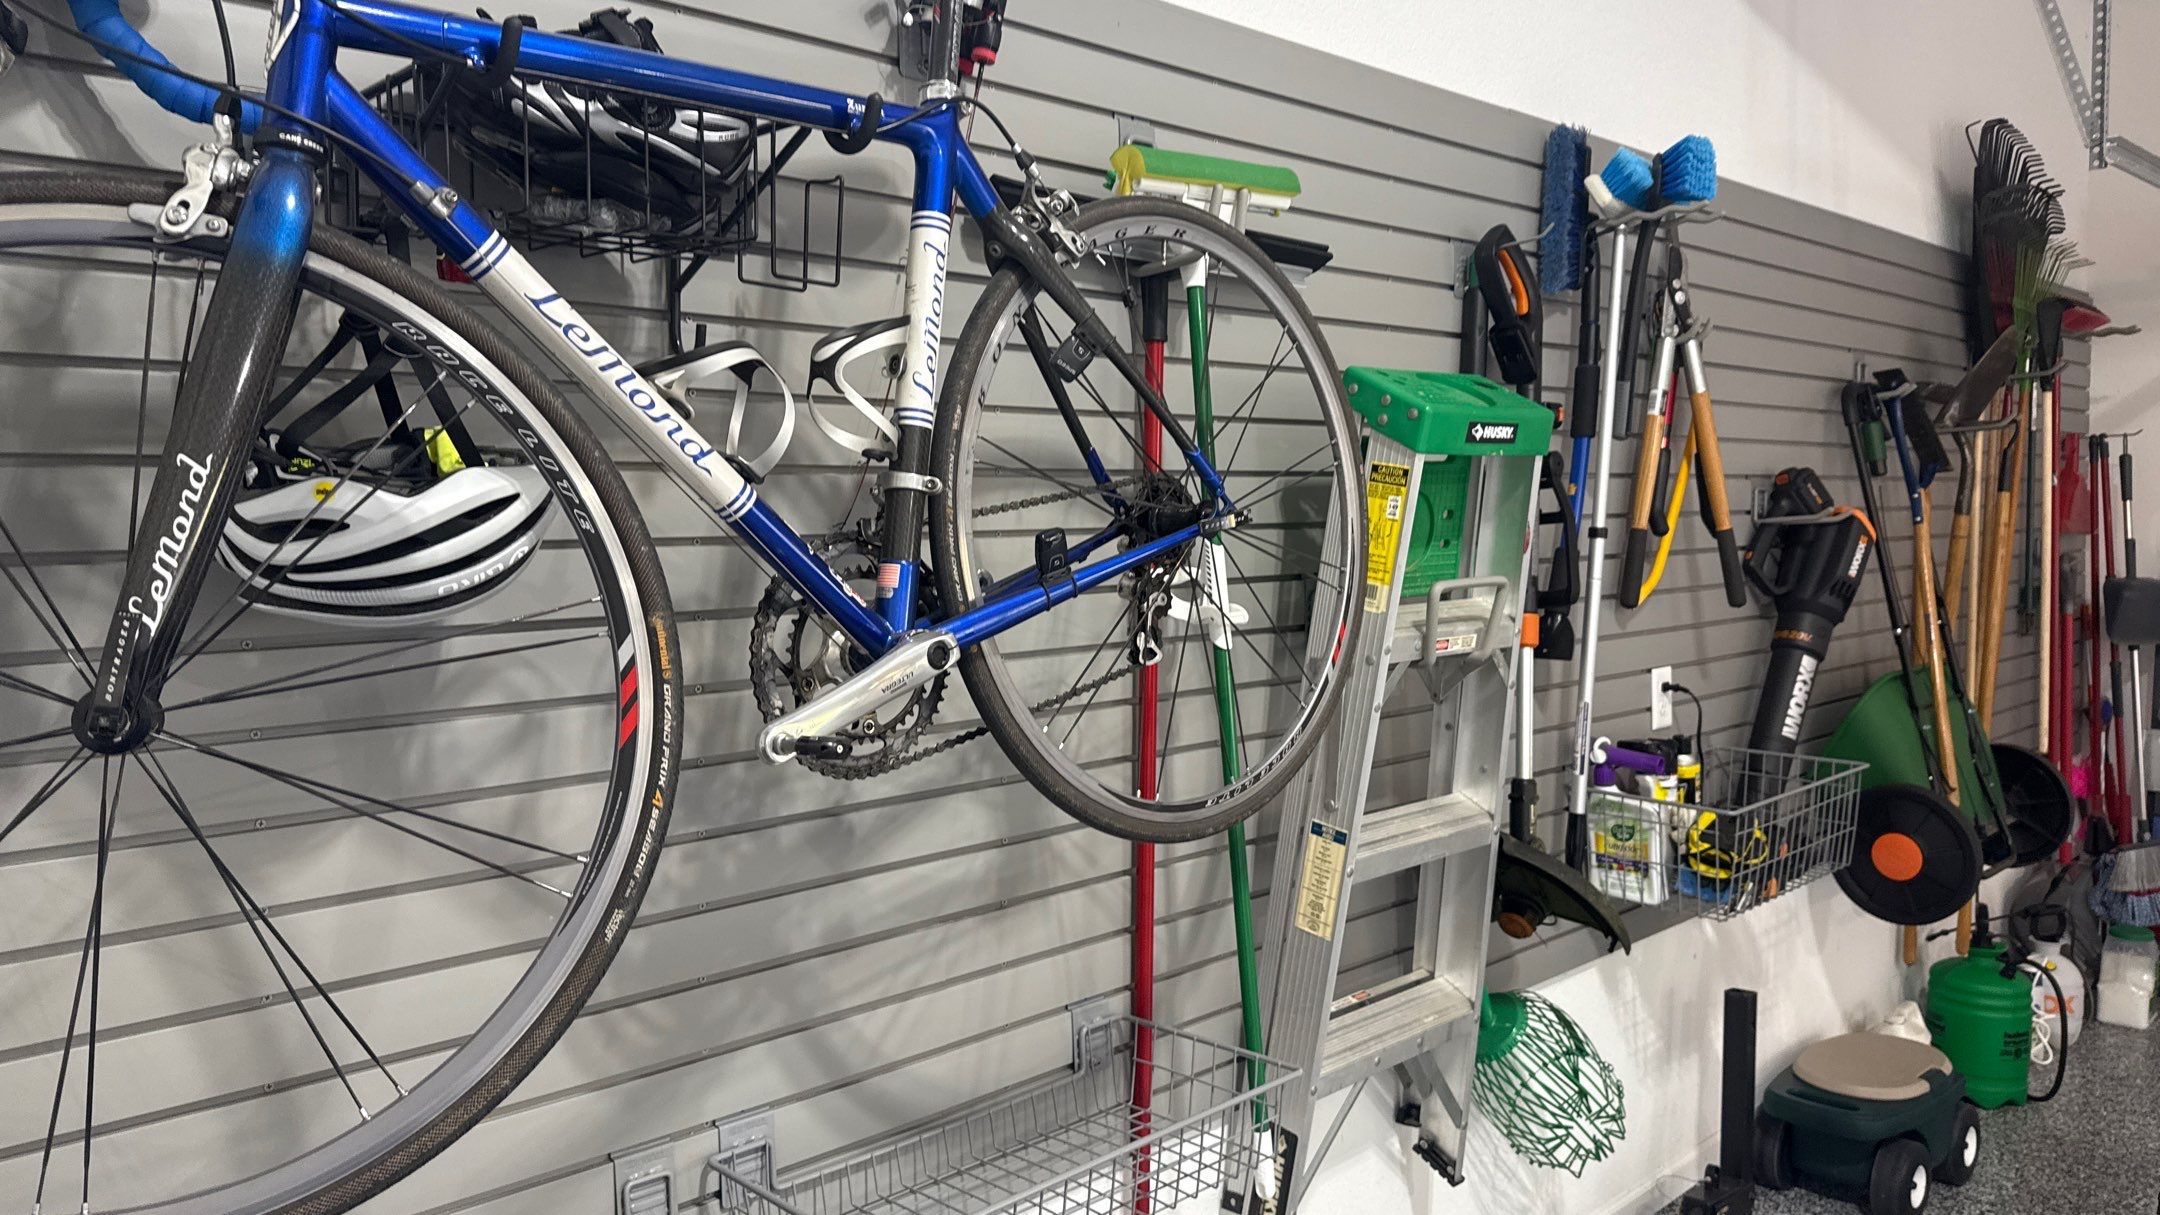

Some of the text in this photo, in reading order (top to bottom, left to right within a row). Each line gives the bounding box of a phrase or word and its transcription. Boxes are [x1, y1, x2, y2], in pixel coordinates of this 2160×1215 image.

[393, 321, 595, 533] RACE LITE
[1483, 426, 1514, 439] HUSKY
[1378, 466, 1404, 476] CAUTION
[105, 620, 130, 702] BONTRAGER
[881, 670, 914, 694] ULTEGRA
[662, 683, 673, 744] GRAND
[1781, 660, 1817, 741] WORX
[658, 744, 670, 789] PRIX
[652, 787, 665, 809] 4
